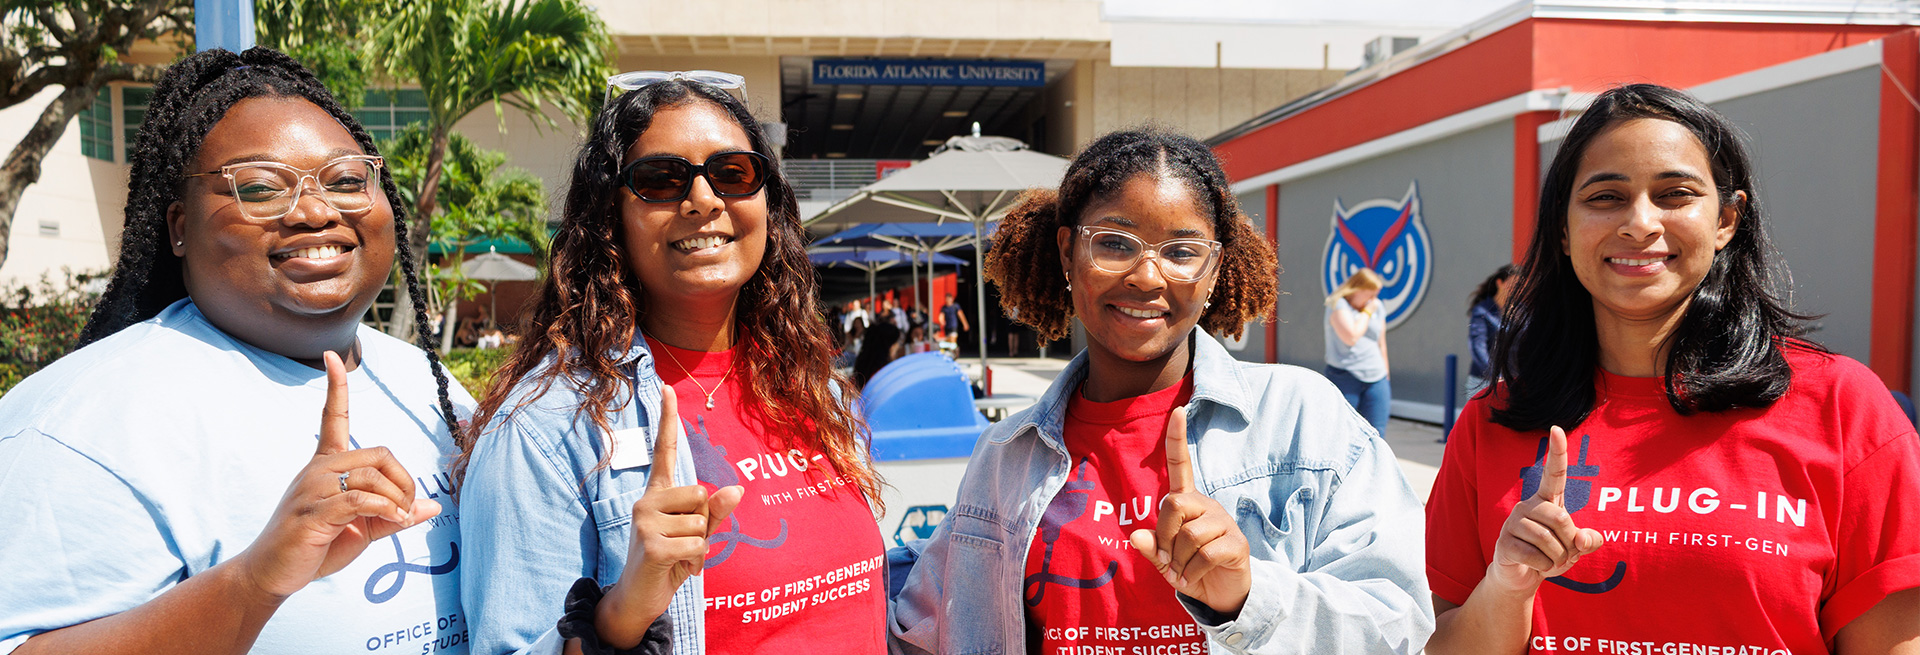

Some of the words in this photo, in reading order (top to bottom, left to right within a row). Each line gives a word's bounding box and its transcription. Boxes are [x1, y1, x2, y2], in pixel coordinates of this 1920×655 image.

[818, 64, 878, 79] FLORIDA
[882, 64, 953, 79] ATLANTIC
[959, 64, 1041, 80] UNIVERSITY
[736, 448, 824, 482] PLUG-
[761, 491, 793, 506] WITH
[796, 473, 856, 499] FIRST-GE
[1093, 493, 1169, 526] PLU
[1598, 487, 1806, 527] PLUG-IN
[1098, 535, 1134, 550] WIT
[1603, 530, 1657, 545] WITH
[1669, 532, 1789, 557] FIRST-GEN
[704, 592, 756, 611] FFICE
[760, 586, 781, 603] OF
[784, 554, 884, 598] FIRST-GENERATI
[742, 597, 808, 624] STUDENT
[811, 578, 871, 606] SUCCESS
[366, 622, 432, 651] OFFICE
[437, 613, 457, 630] OF
[421, 630, 469, 655] STUDE
[1064, 626, 1089, 641] OF
[1563, 636, 1591, 651] OF
[1597, 639, 1787, 655] FIRST-GENERATI
